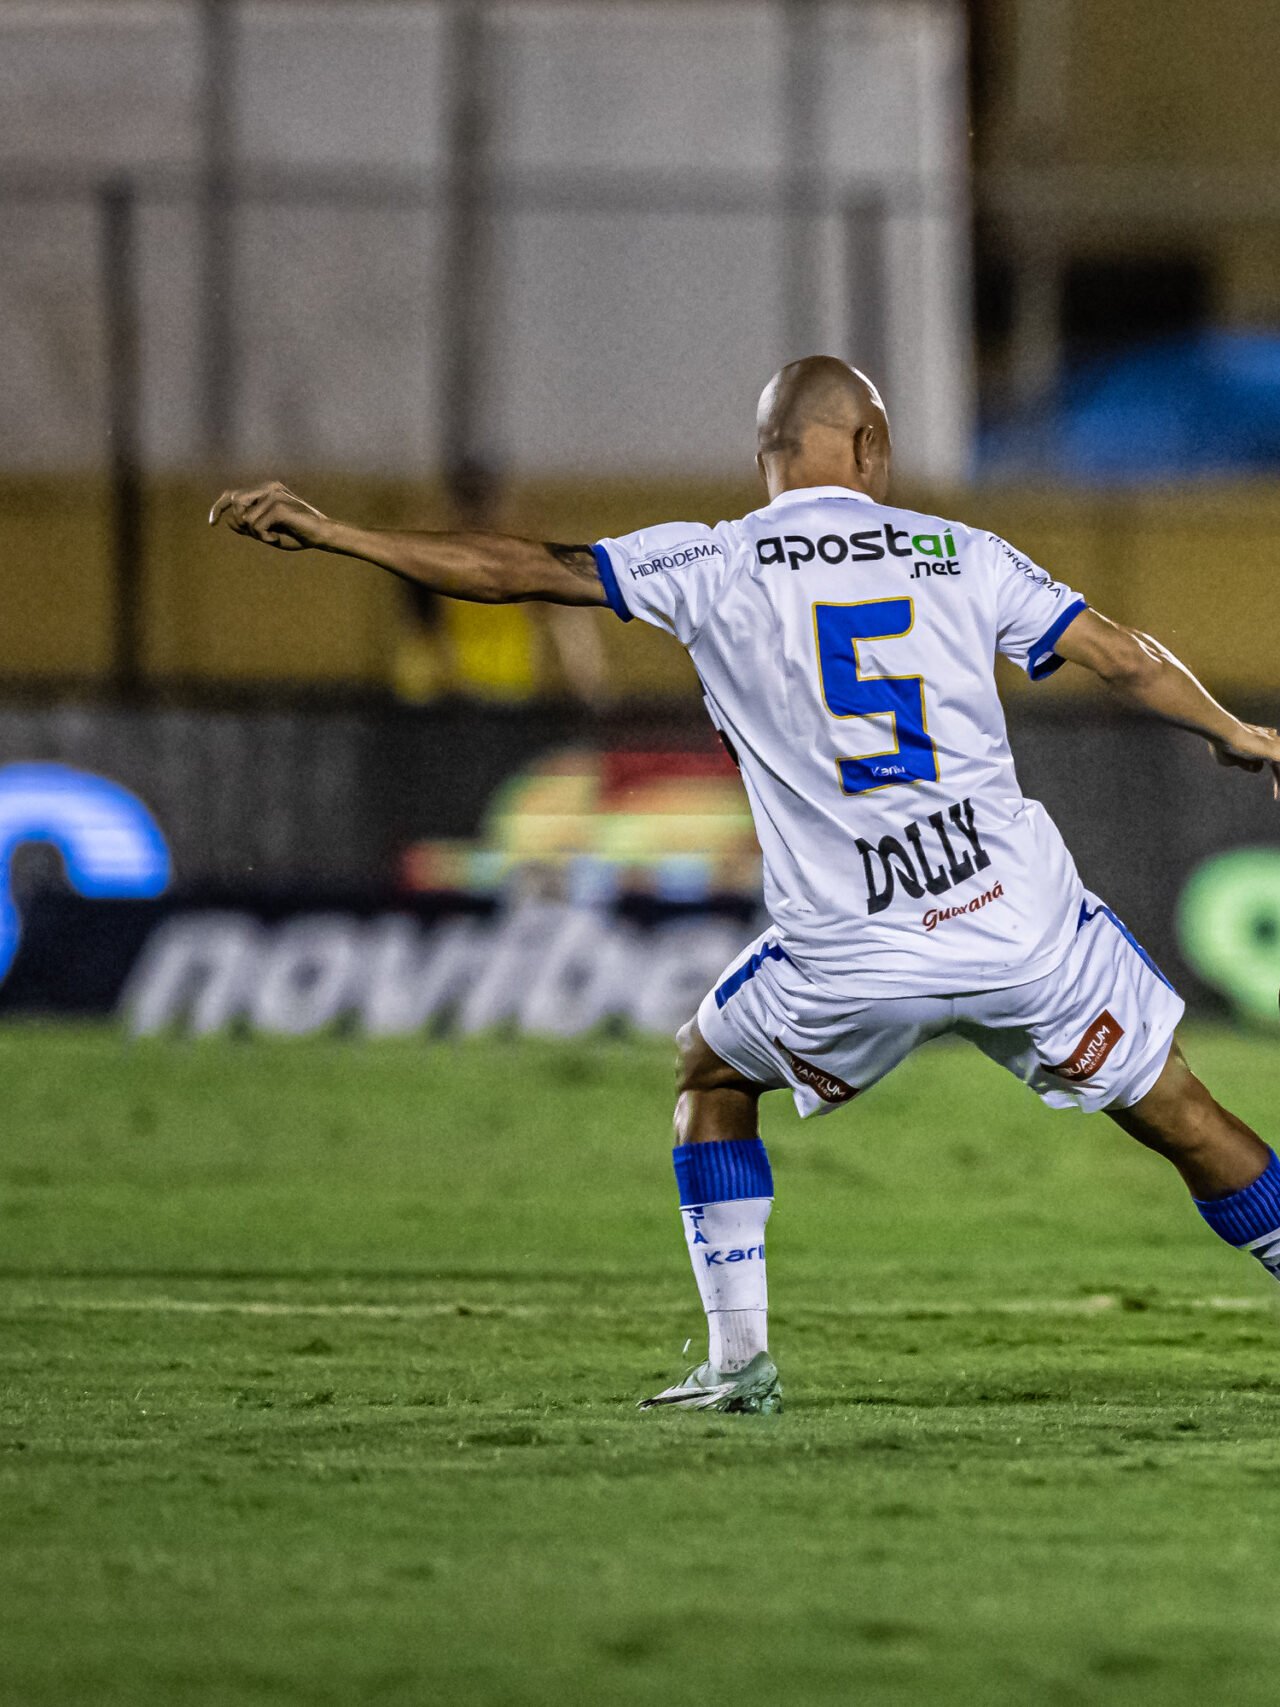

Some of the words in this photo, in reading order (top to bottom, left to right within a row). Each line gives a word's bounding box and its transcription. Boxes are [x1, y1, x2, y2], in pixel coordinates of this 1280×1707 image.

[629, 544, 722, 581] HIDRODEMA
[910, 560, 961, 579] .net
[811, 595, 941, 796] 5
[854, 797, 992, 915] DOLLY
[118, 888, 742, 1036] novibe
